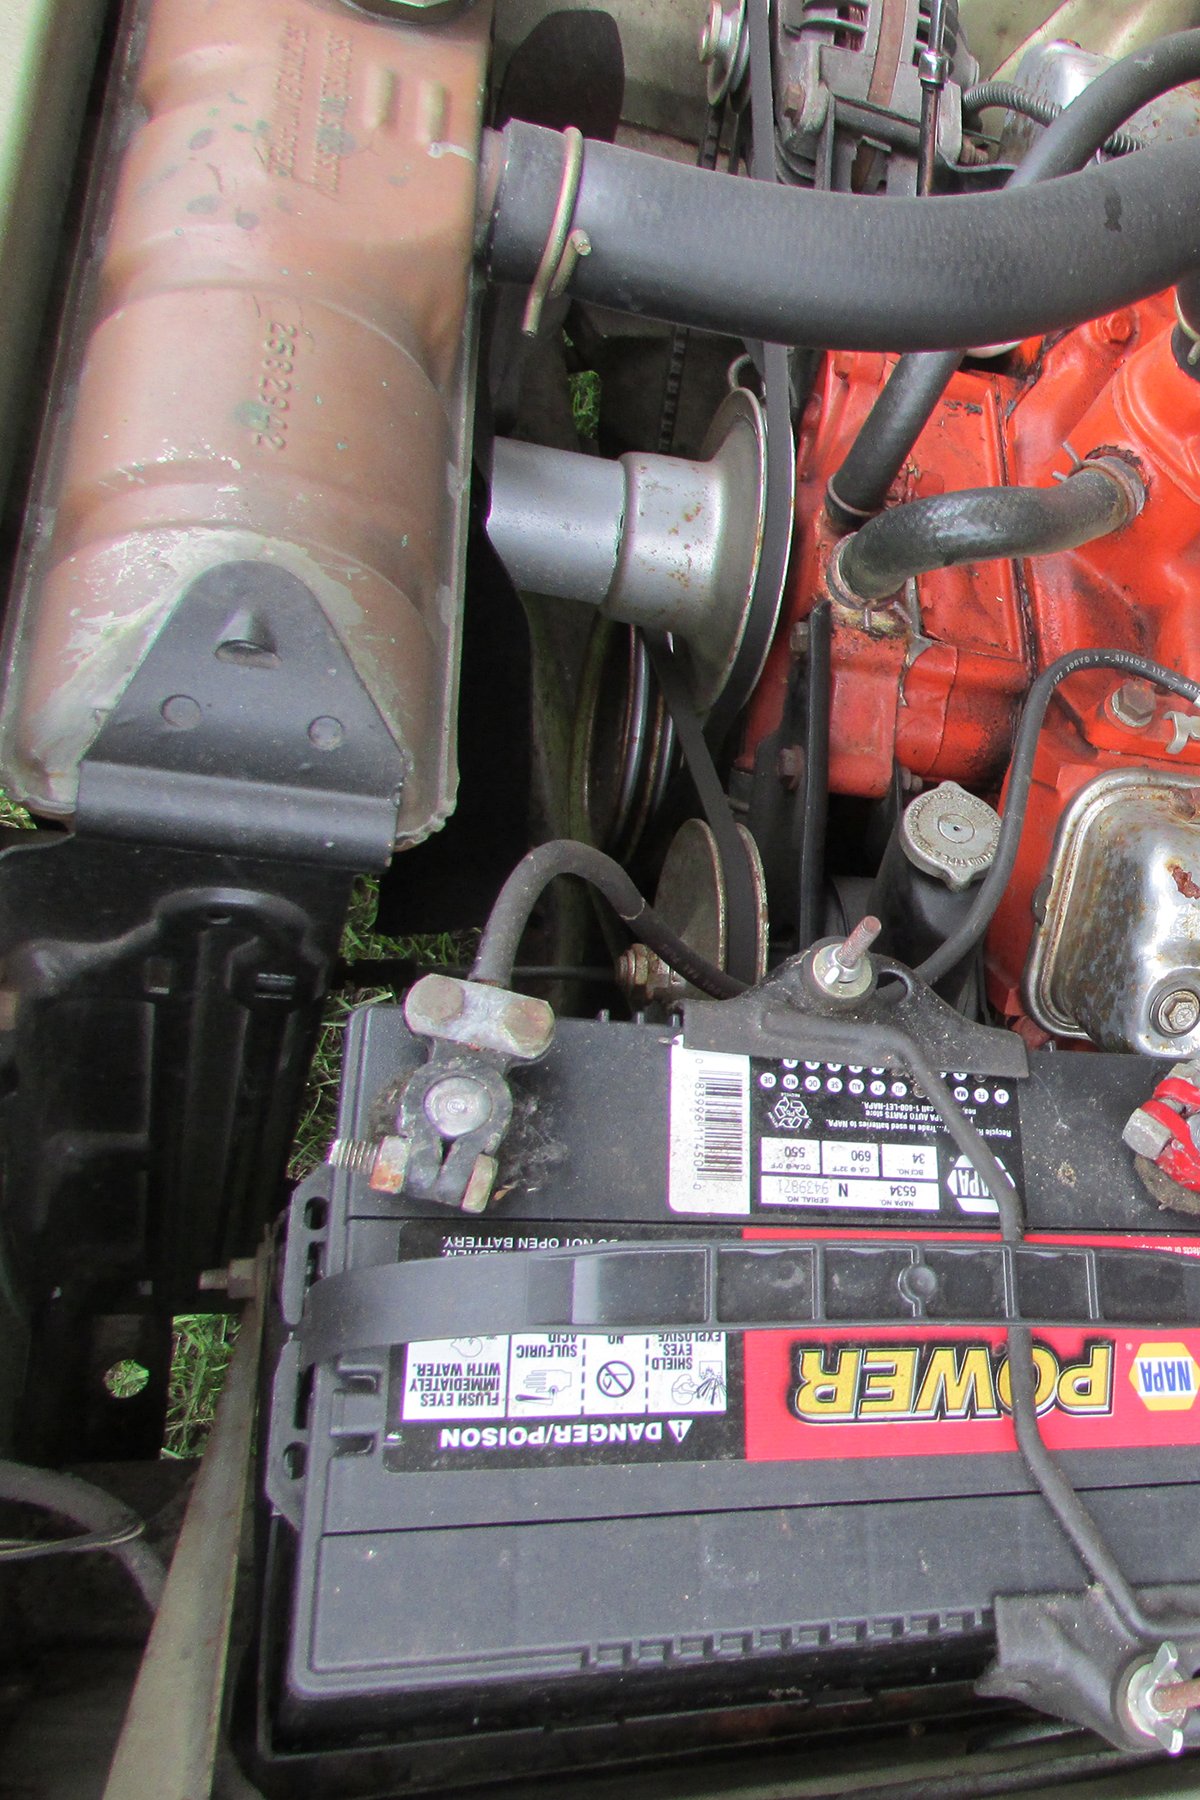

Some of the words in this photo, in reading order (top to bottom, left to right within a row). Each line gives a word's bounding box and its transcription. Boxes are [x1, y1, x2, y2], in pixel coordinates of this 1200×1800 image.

[884, 1111, 908, 1120] PARTS
[909, 1112, 929, 1121] AUTO
[859, 1120, 890, 1130] batteries
[985, 1127, 1012, 1138] Recycle
[784, 1146, 806, 1159] 550
[850, 1150, 872, 1162] 690
[911, 1152, 926, 1165] 34
[859, 1166, 870, 1174] CA
[838, 1183, 849, 1197] N
[889, 1185, 917, 1197] 6534
[802, 1196, 830, 1204] SERIAL
[442, 1236, 514, 1248] BATTERY.
[518, 1237, 560, 1249] OPEN
[515, 1344, 578, 1358] SULFURIC
[658, 1343, 693, 1356] EYES.
[412, 1363, 463, 1377] WATER.
[466, 1362, 501, 1377] WITH
[651, 1357, 693, 1371] SHIELD
[791, 1340, 1114, 1424] POWER
[1139, 1360, 1192, 1393] NAPA
[410, 1377, 500, 1392] IMMEDIATELY
[420, 1392, 455, 1407] EYES
[459, 1392, 499, 1406] FLUSH
[440, 1422, 663, 1448] DANGER/POISON
